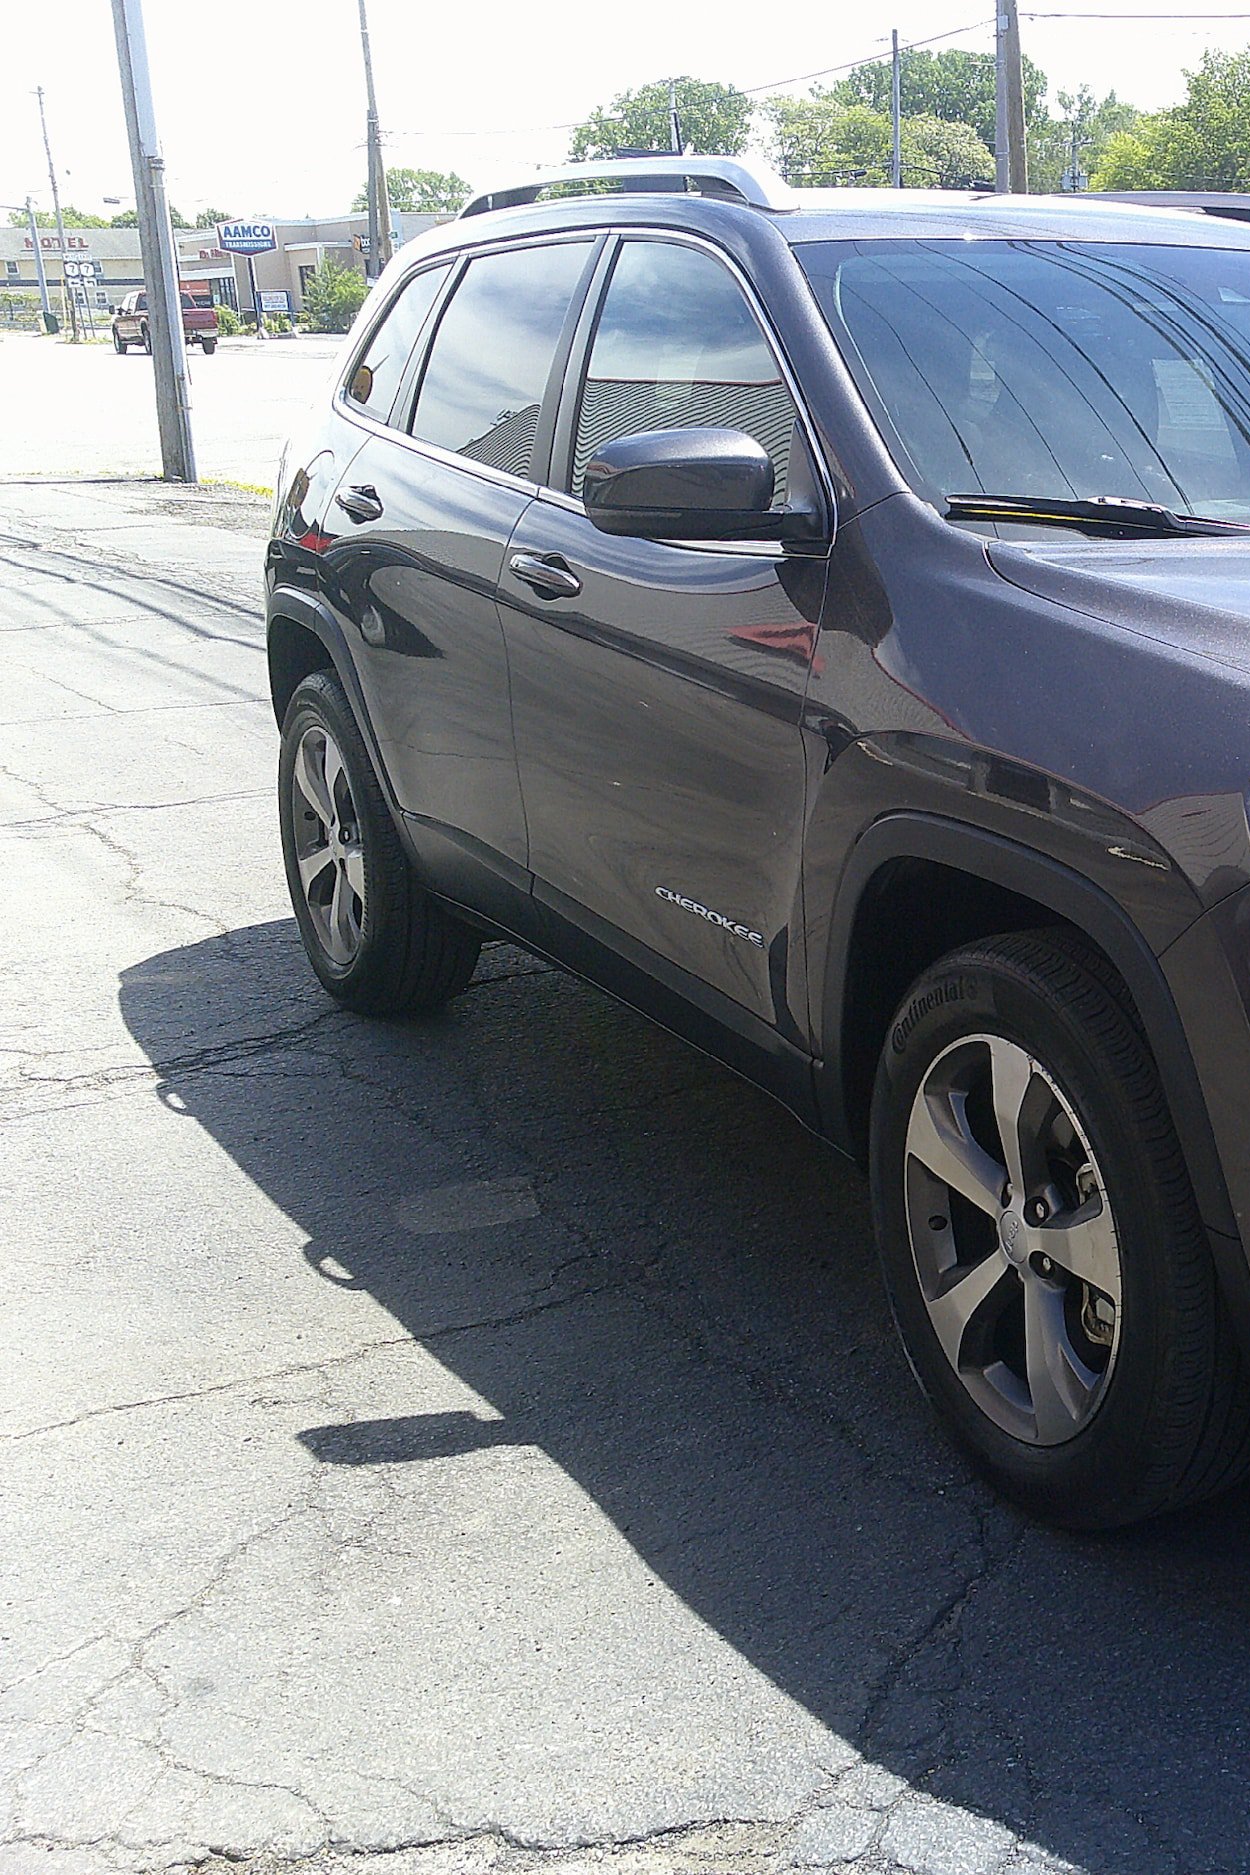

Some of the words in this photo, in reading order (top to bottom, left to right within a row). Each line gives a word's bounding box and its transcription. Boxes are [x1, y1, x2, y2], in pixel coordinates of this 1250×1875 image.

[223, 225, 271, 238] AAMCO
[69, 265, 76, 273] 7
[84, 265, 90, 273] 7
[655, 885, 764, 948] CHEROKEE
[892, 976, 965, 1055] Continental
